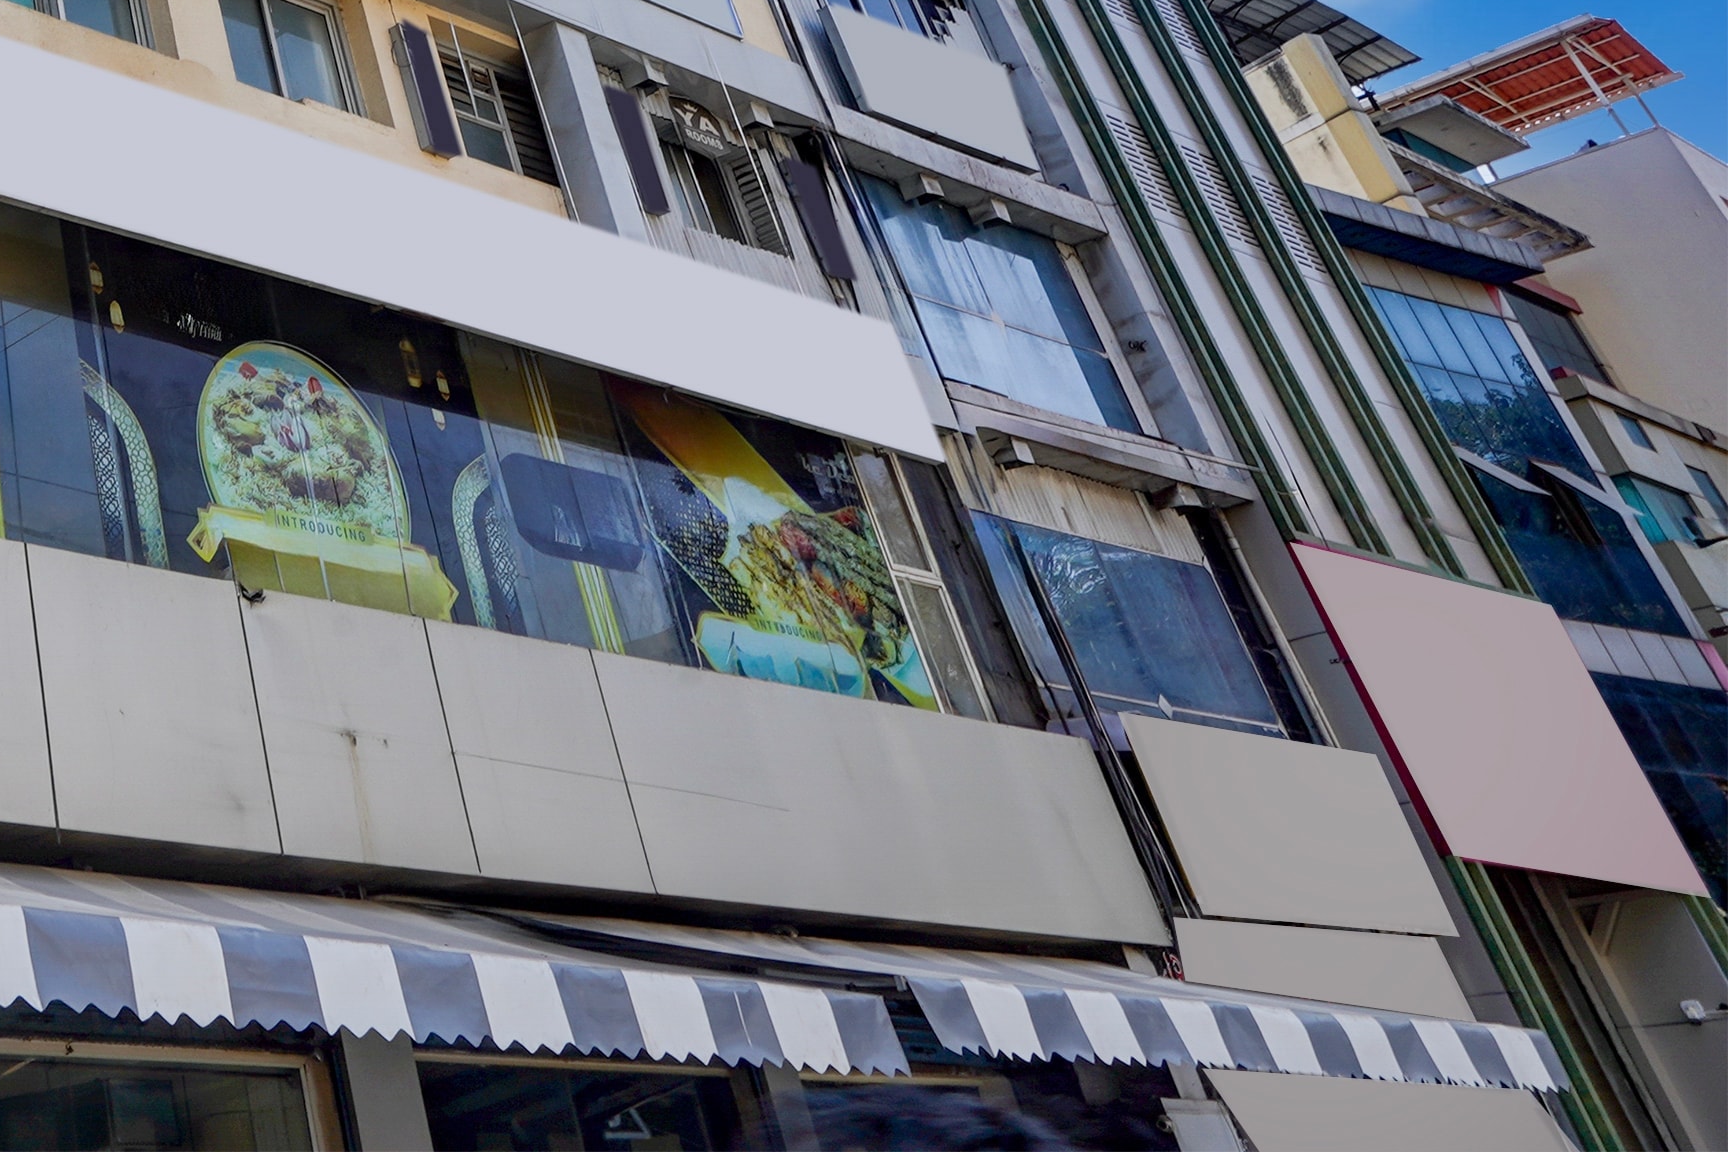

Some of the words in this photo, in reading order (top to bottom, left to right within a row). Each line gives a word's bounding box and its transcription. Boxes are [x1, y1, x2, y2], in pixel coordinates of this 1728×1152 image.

[672, 106, 721, 137] YA
[685, 128, 724, 150] ROOMS
[276, 514, 366, 542] INTRODUCING
